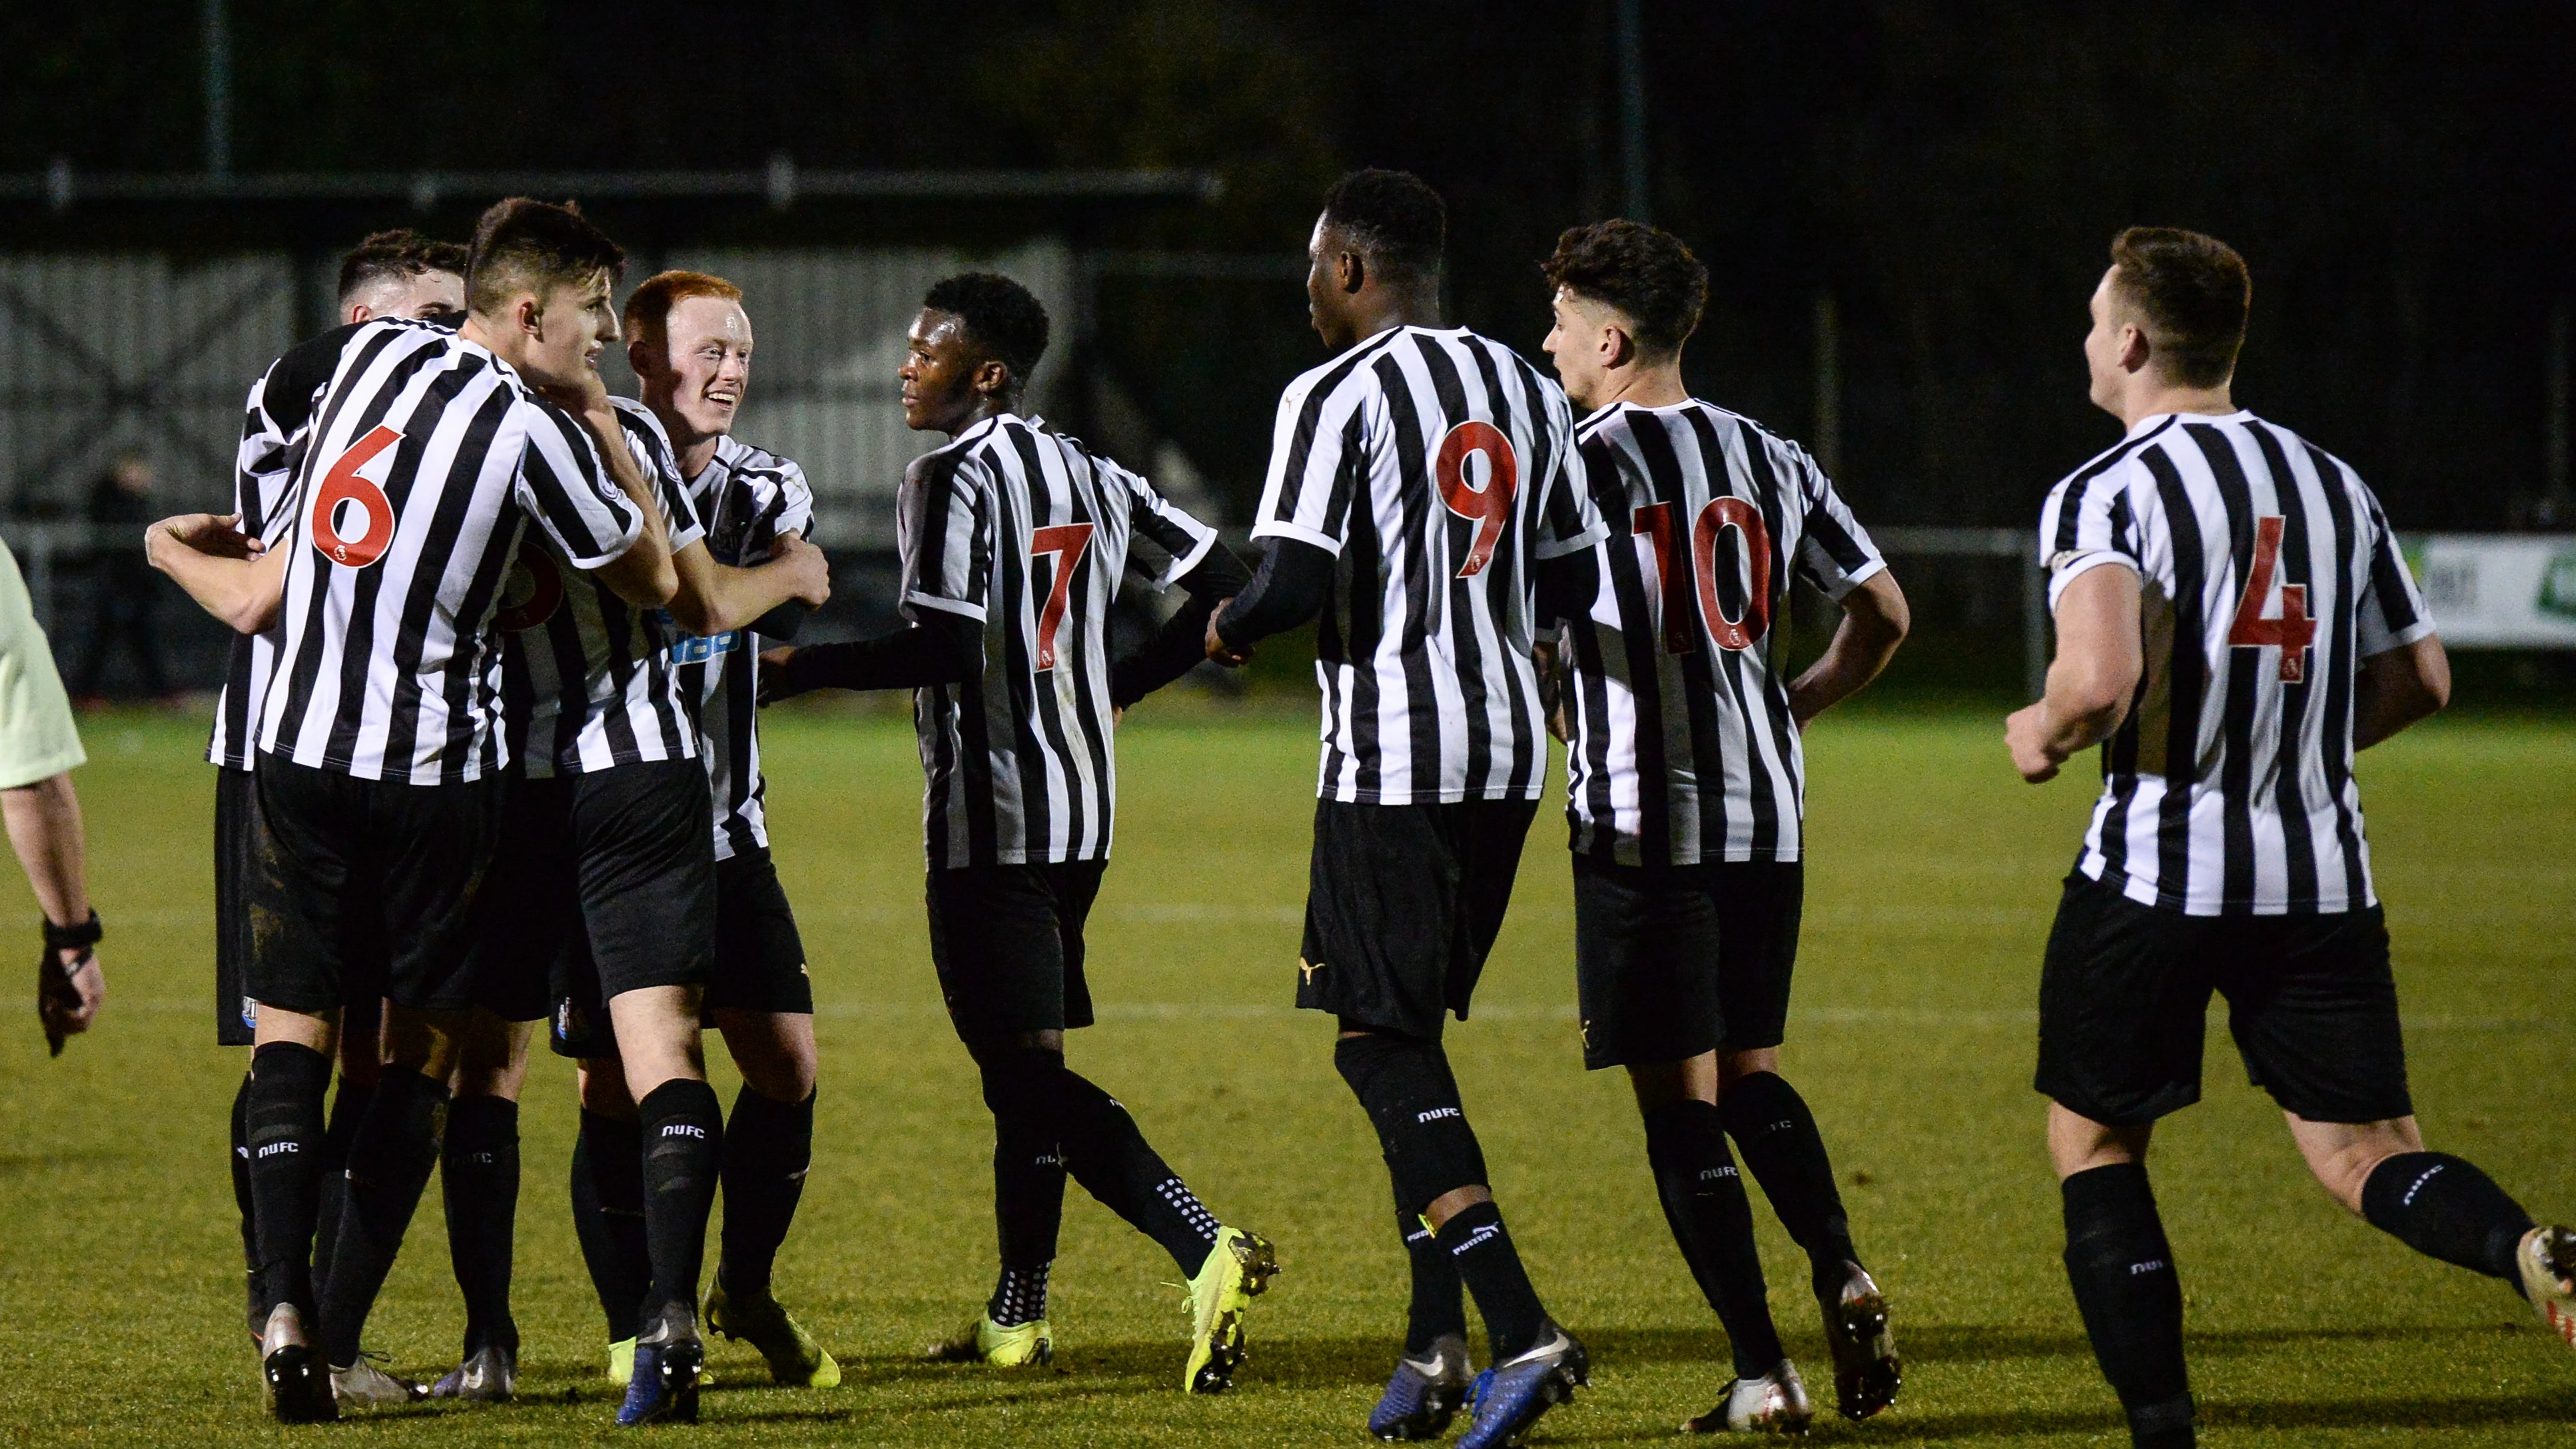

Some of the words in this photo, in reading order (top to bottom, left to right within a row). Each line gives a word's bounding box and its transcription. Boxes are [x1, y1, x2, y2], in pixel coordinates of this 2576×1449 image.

[312, 424, 405, 569] 6
[1436, 420, 1518, 578] 9
[1631, 496, 1772, 654] 10
[1031, 522, 1094, 672] 7
[2228, 516, 2317, 684] 4
